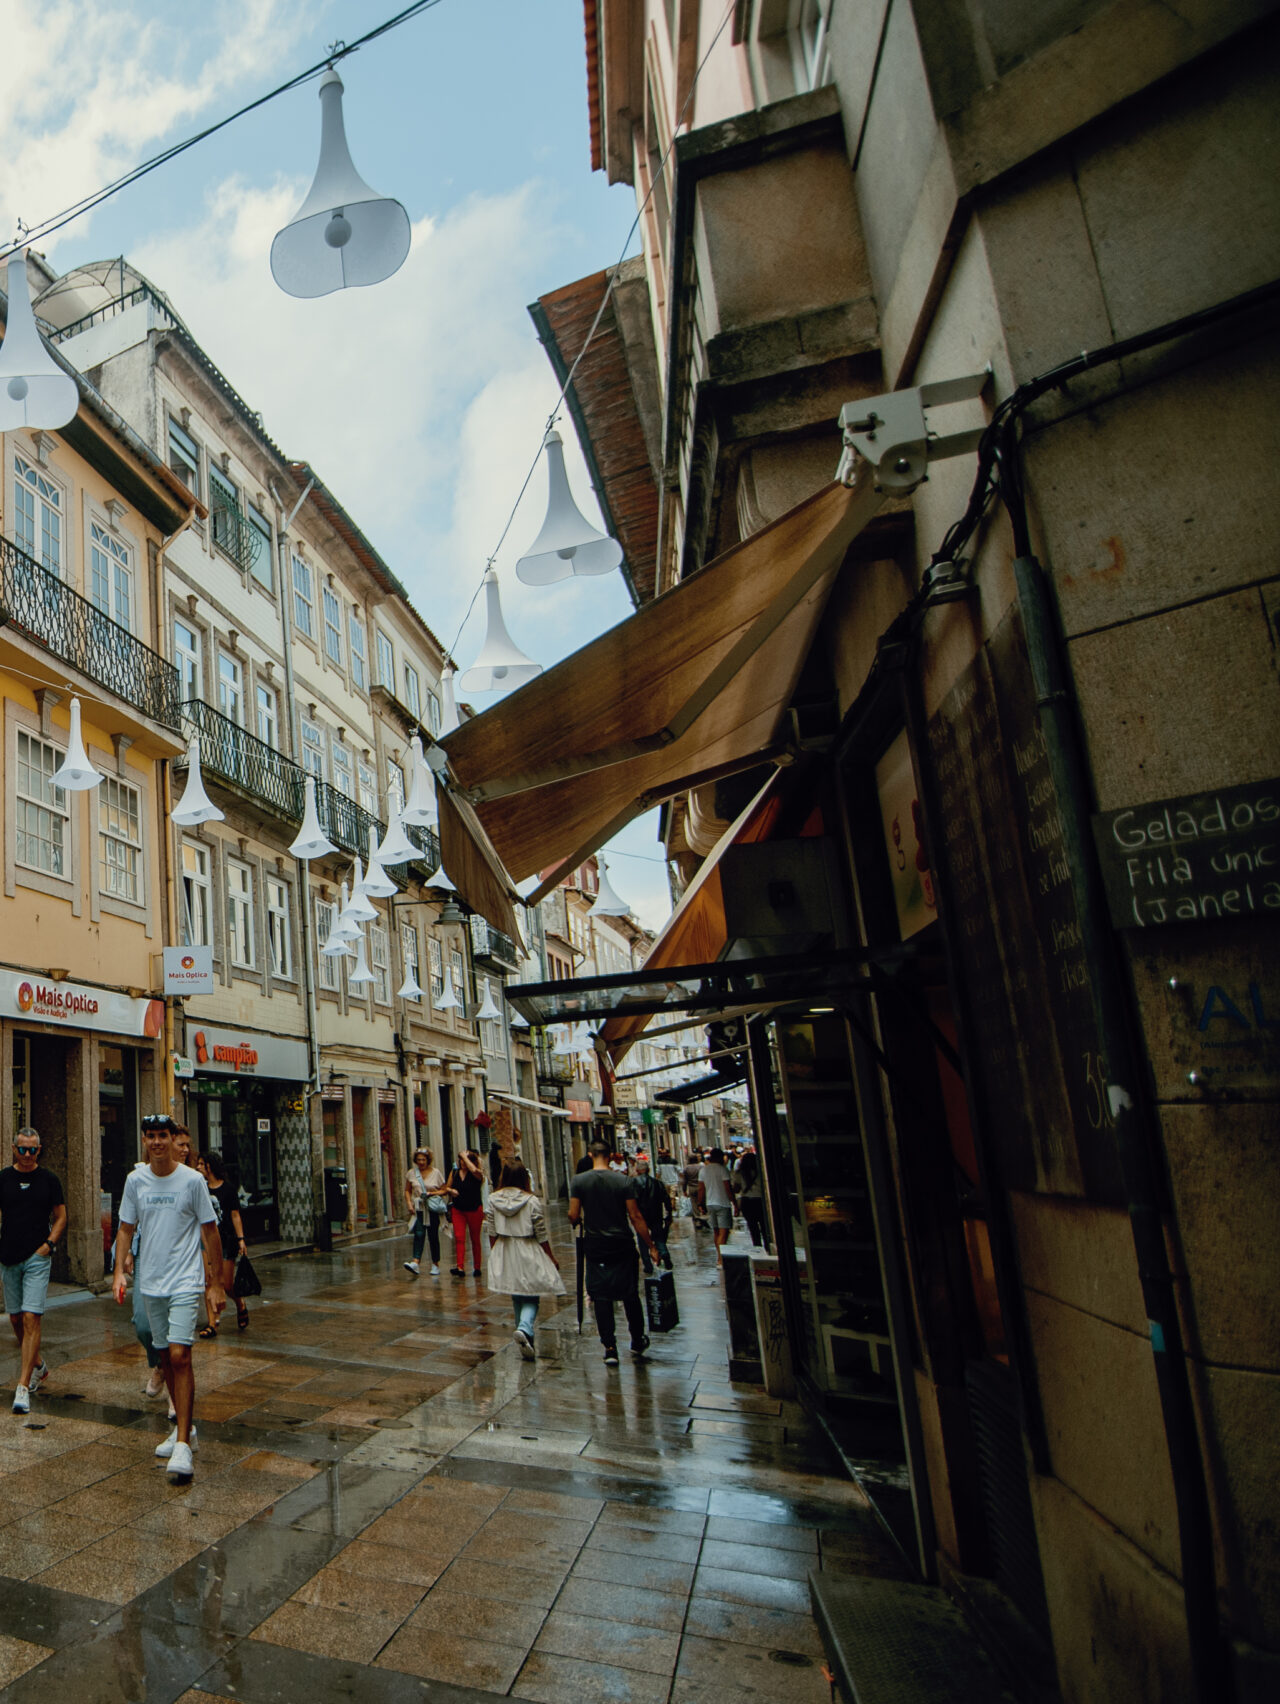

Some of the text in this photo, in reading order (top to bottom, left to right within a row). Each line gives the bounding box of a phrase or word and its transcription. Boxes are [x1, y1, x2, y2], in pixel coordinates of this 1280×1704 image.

[1113, 797, 1280, 847] Gelados
[1126, 856, 1192, 888] Fila
[185, 971, 208, 979] Optica
[36, 984, 99, 1014] Mais Optica
